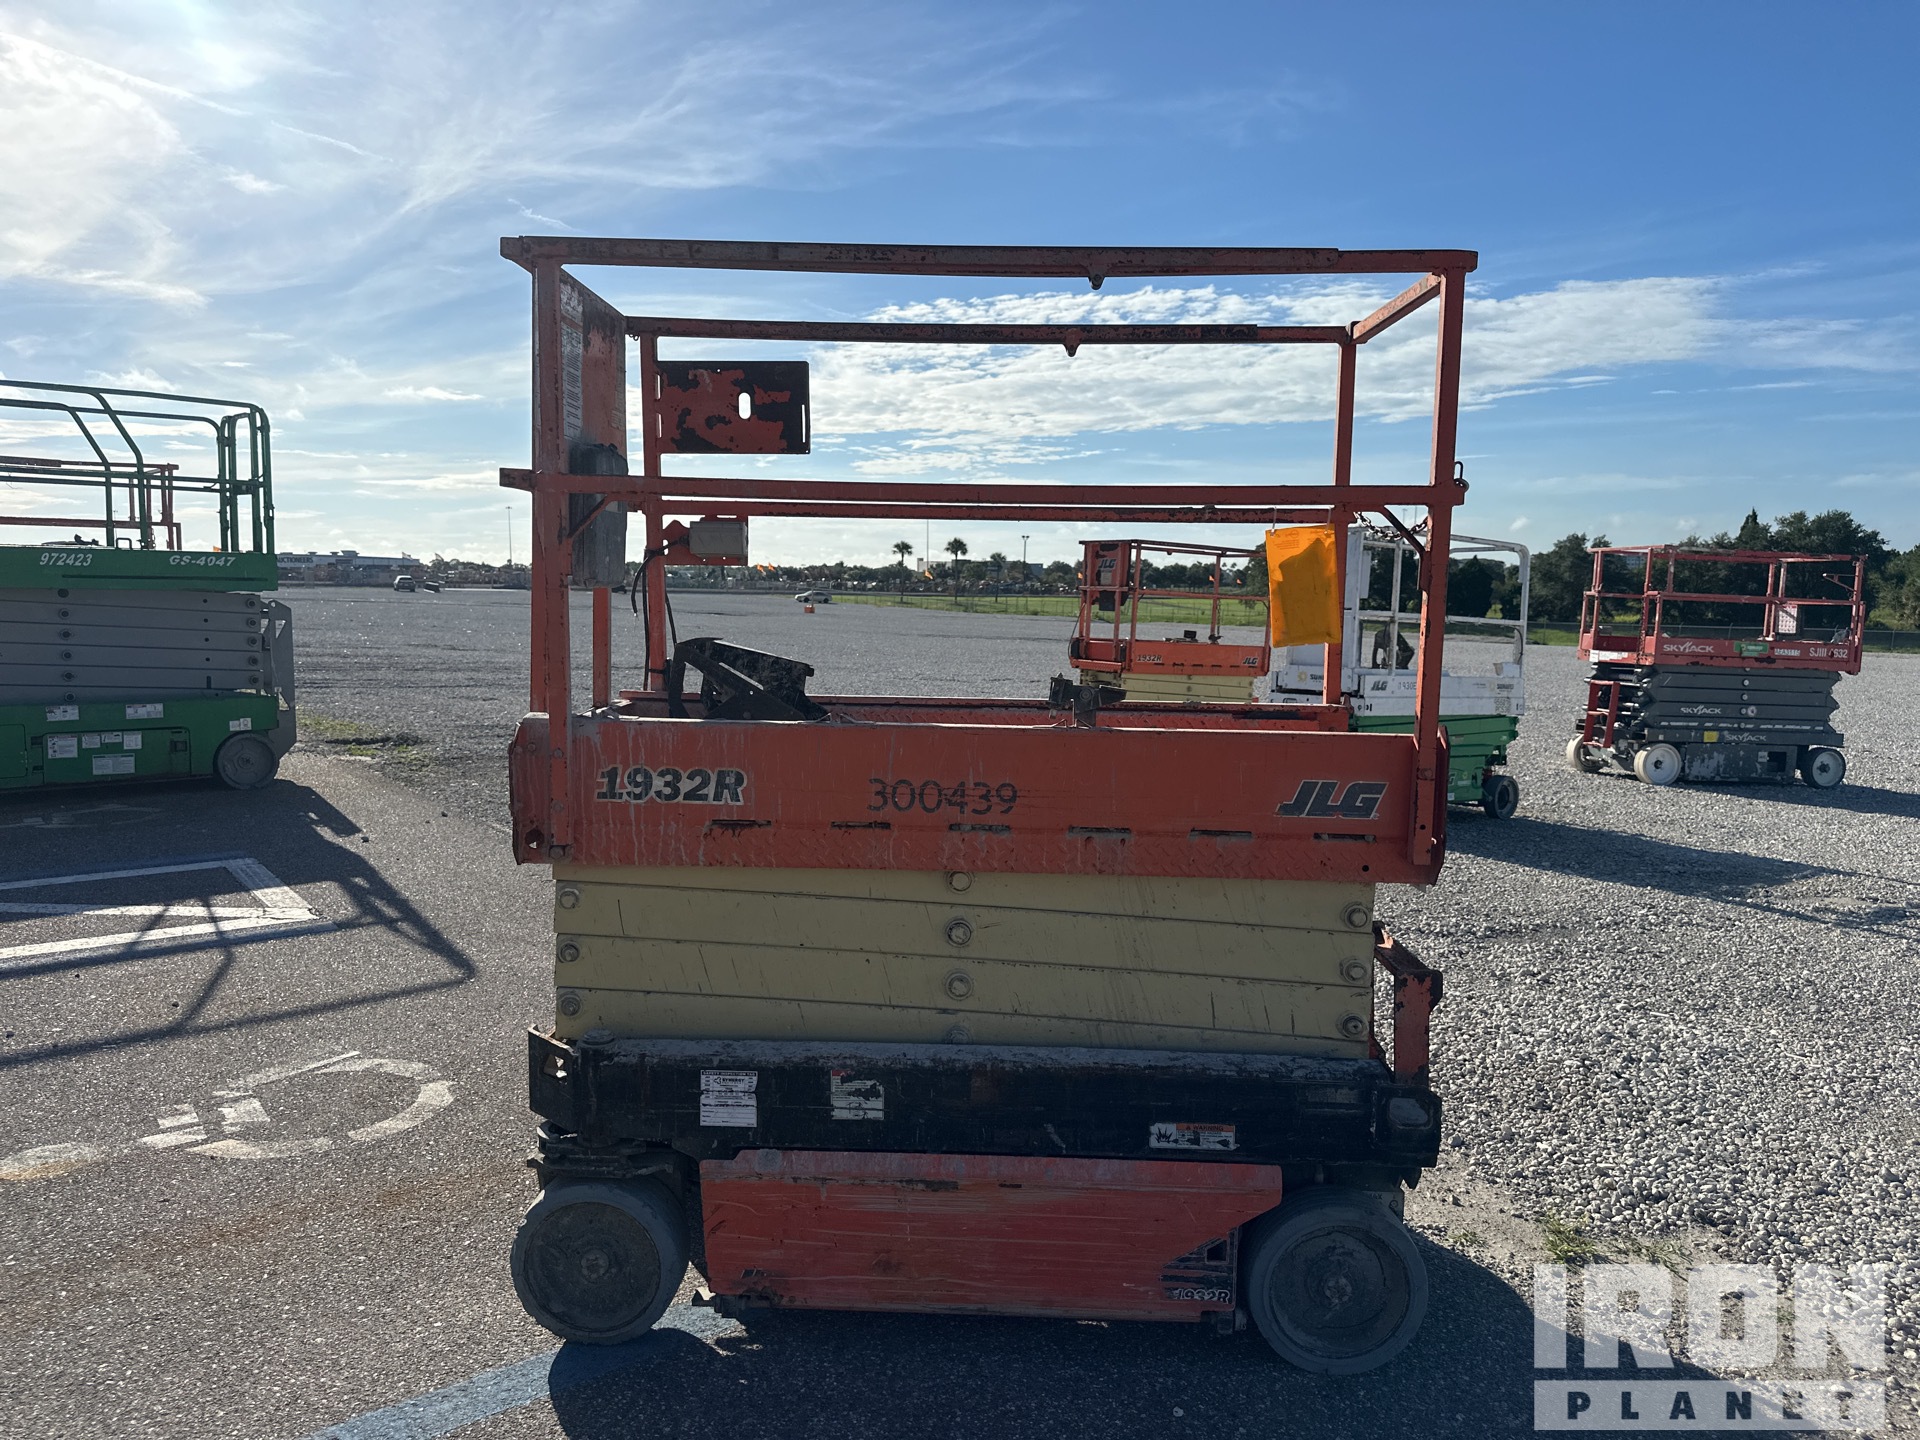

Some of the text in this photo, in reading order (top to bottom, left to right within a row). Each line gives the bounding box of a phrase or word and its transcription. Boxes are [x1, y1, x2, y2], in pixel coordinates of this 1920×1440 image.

[39, 552, 93, 566] 972423
[169, 555, 236, 567] GS-4047
[1098, 558, 1117, 569] JLG
[1663, 641, 1714, 653] SKYJACK
[1137, 654, 1162, 663] 1932R
[1243, 656, 1259, 665] JLG
[1371, 680, 1388, 691] JLG
[1680, 705, 1722, 715] SKYJACK
[1725, 732, 1767, 742] SKYJACK
[596, 767, 747, 805] 1932R
[868, 778, 1017, 815] 300439
[1275, 779, 1389, 820] JLG
[1192, 1124, 1224, 1132] WARNING
[1173, 1288, 1230, 1304] 1932R
